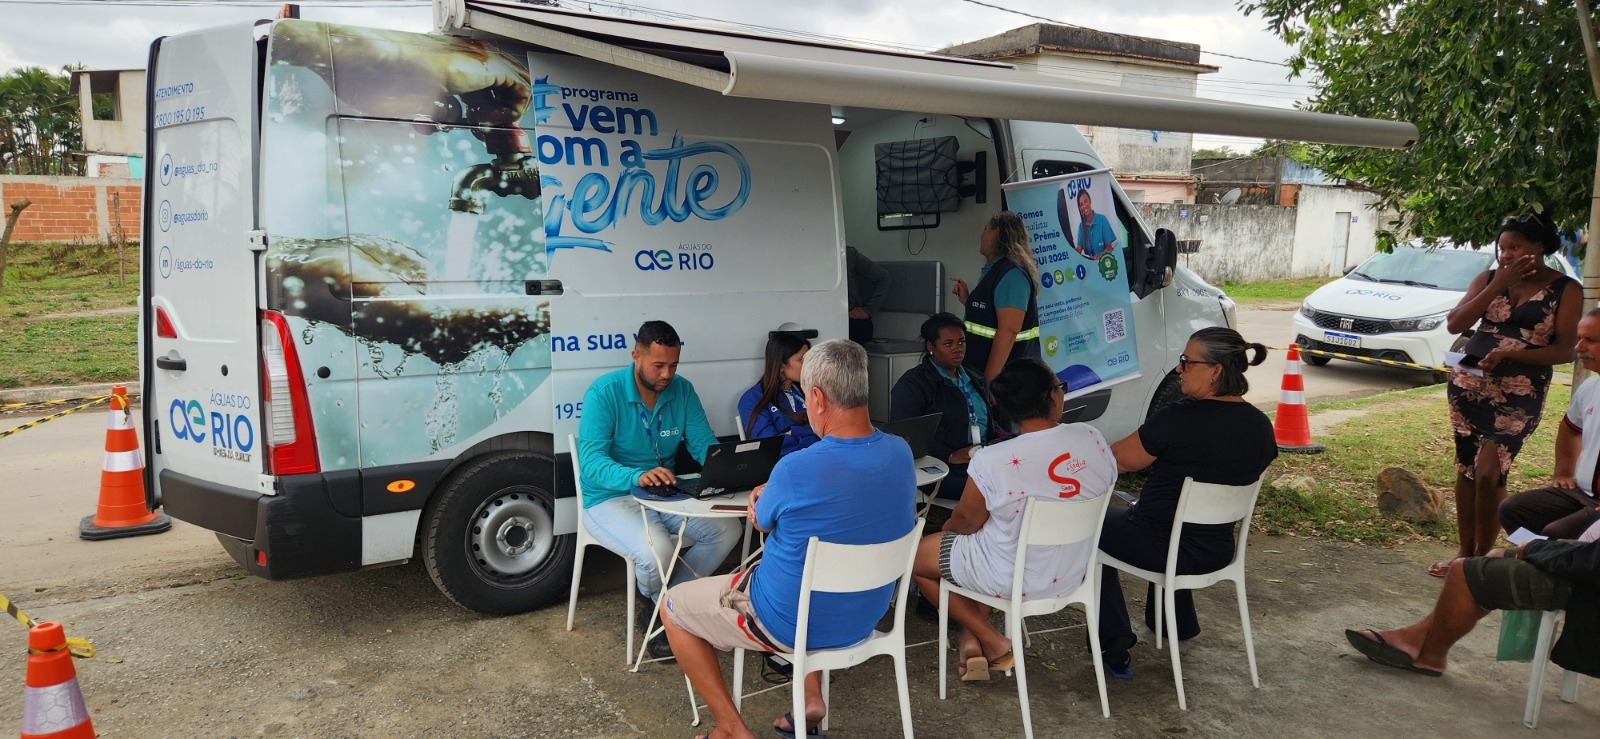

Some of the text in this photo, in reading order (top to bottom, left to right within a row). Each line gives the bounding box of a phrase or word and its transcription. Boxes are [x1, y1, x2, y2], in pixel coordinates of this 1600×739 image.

[156, 82, 194, 98] ATENDIMENTO
[562, 86, 638, 102] programa
[154, 106, 205, 127] 0800 195 0 195
[537, 134, 645, 169] om a
[174, 209, 208, 225] @aguasdorio
[1017, 210, 1044, 220] Somos
[1034, 229, 1060, 242] Prêmio
[679, 252, 714, 270] RIO
[1034, 251, 1069, 268] QUI 2025!
[1373, 292, 1401, 300] RIO
[1340, 318, 1354, 330] FIAT
[552, 336, 580, 352] na
[587, 333, 627, 351] sua
[1118, 354, 1130, 364] RIO
[210, 388, 251, 409] ÁGUAS DO
[556, 402, 583, 420] 195
[211, 412, 253, 452] RIO
